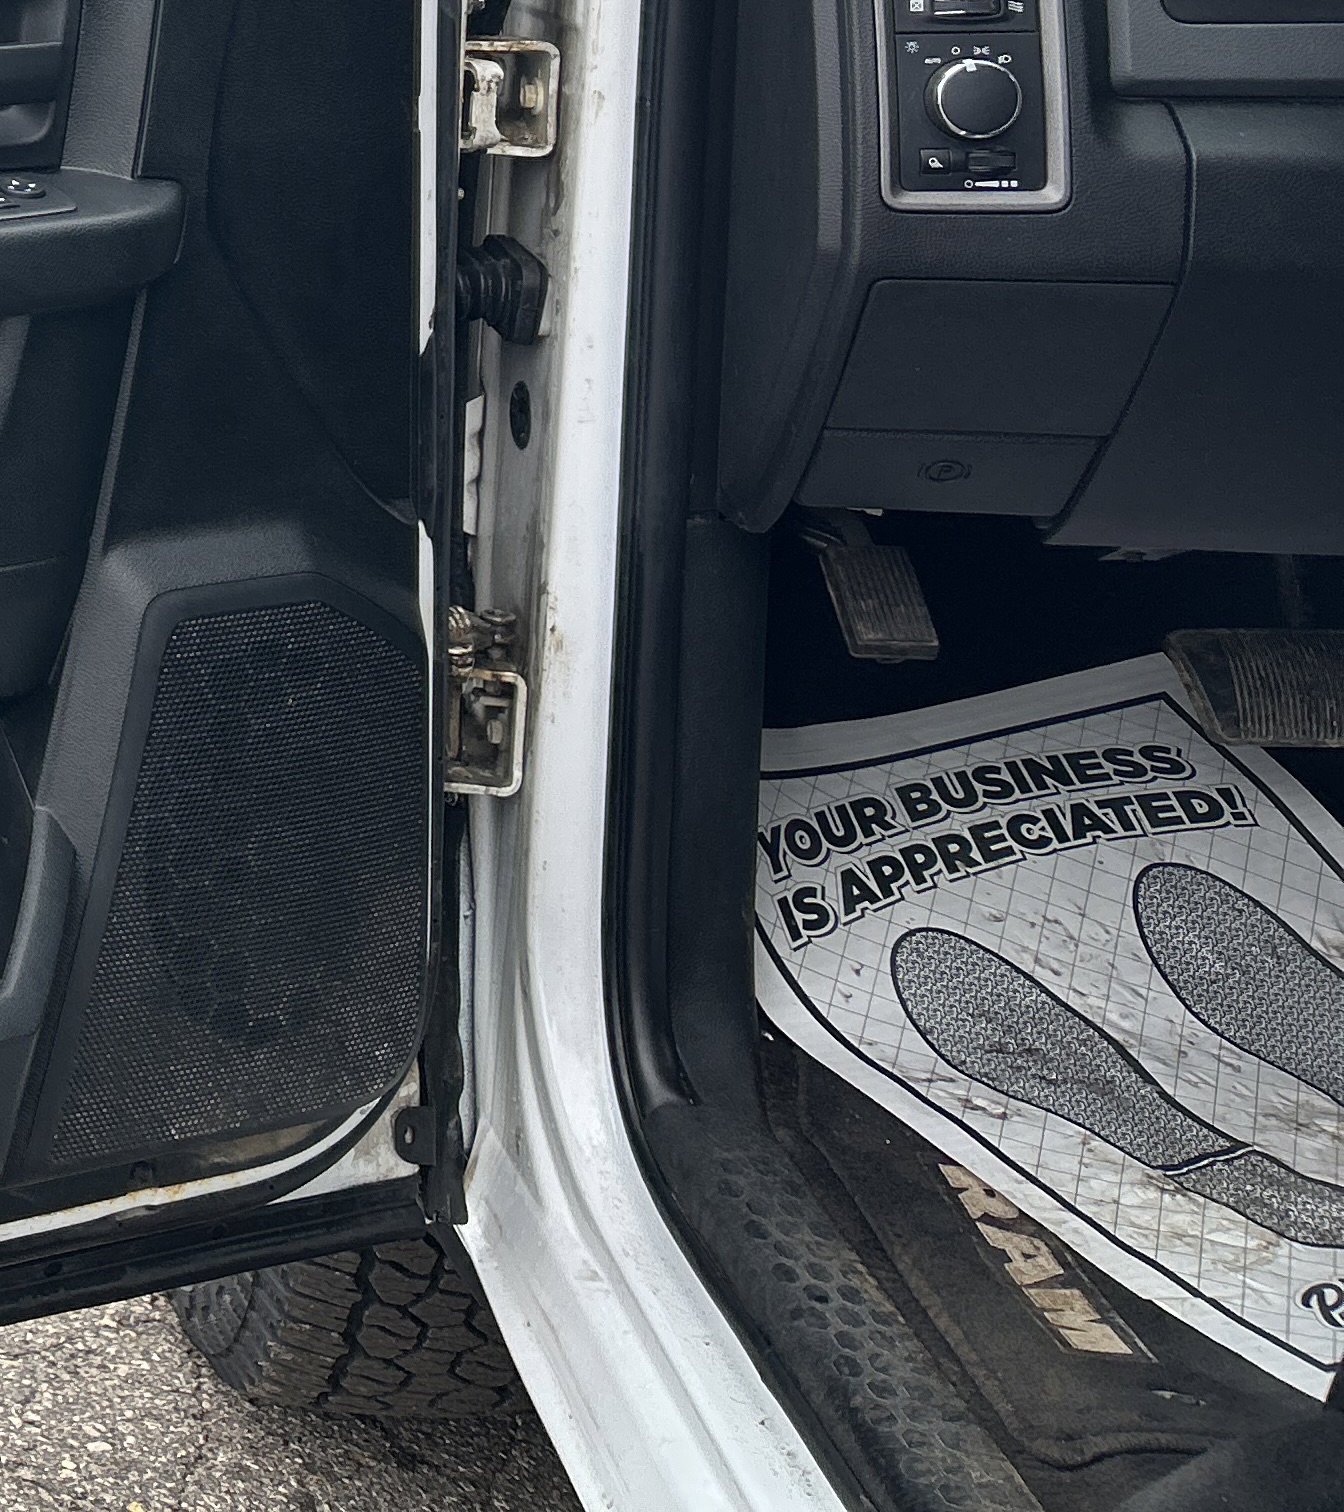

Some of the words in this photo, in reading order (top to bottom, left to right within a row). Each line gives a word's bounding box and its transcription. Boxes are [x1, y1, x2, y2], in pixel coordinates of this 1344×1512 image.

[758, 796, 894, 879] YOUR
[909, 744, 1190, 821] BUSINESS
[775, 885, 833, 945] IS
[842, 786, 1256, 918] APPRECIATED!
[938, 1163, 1134, 1355] RAM
